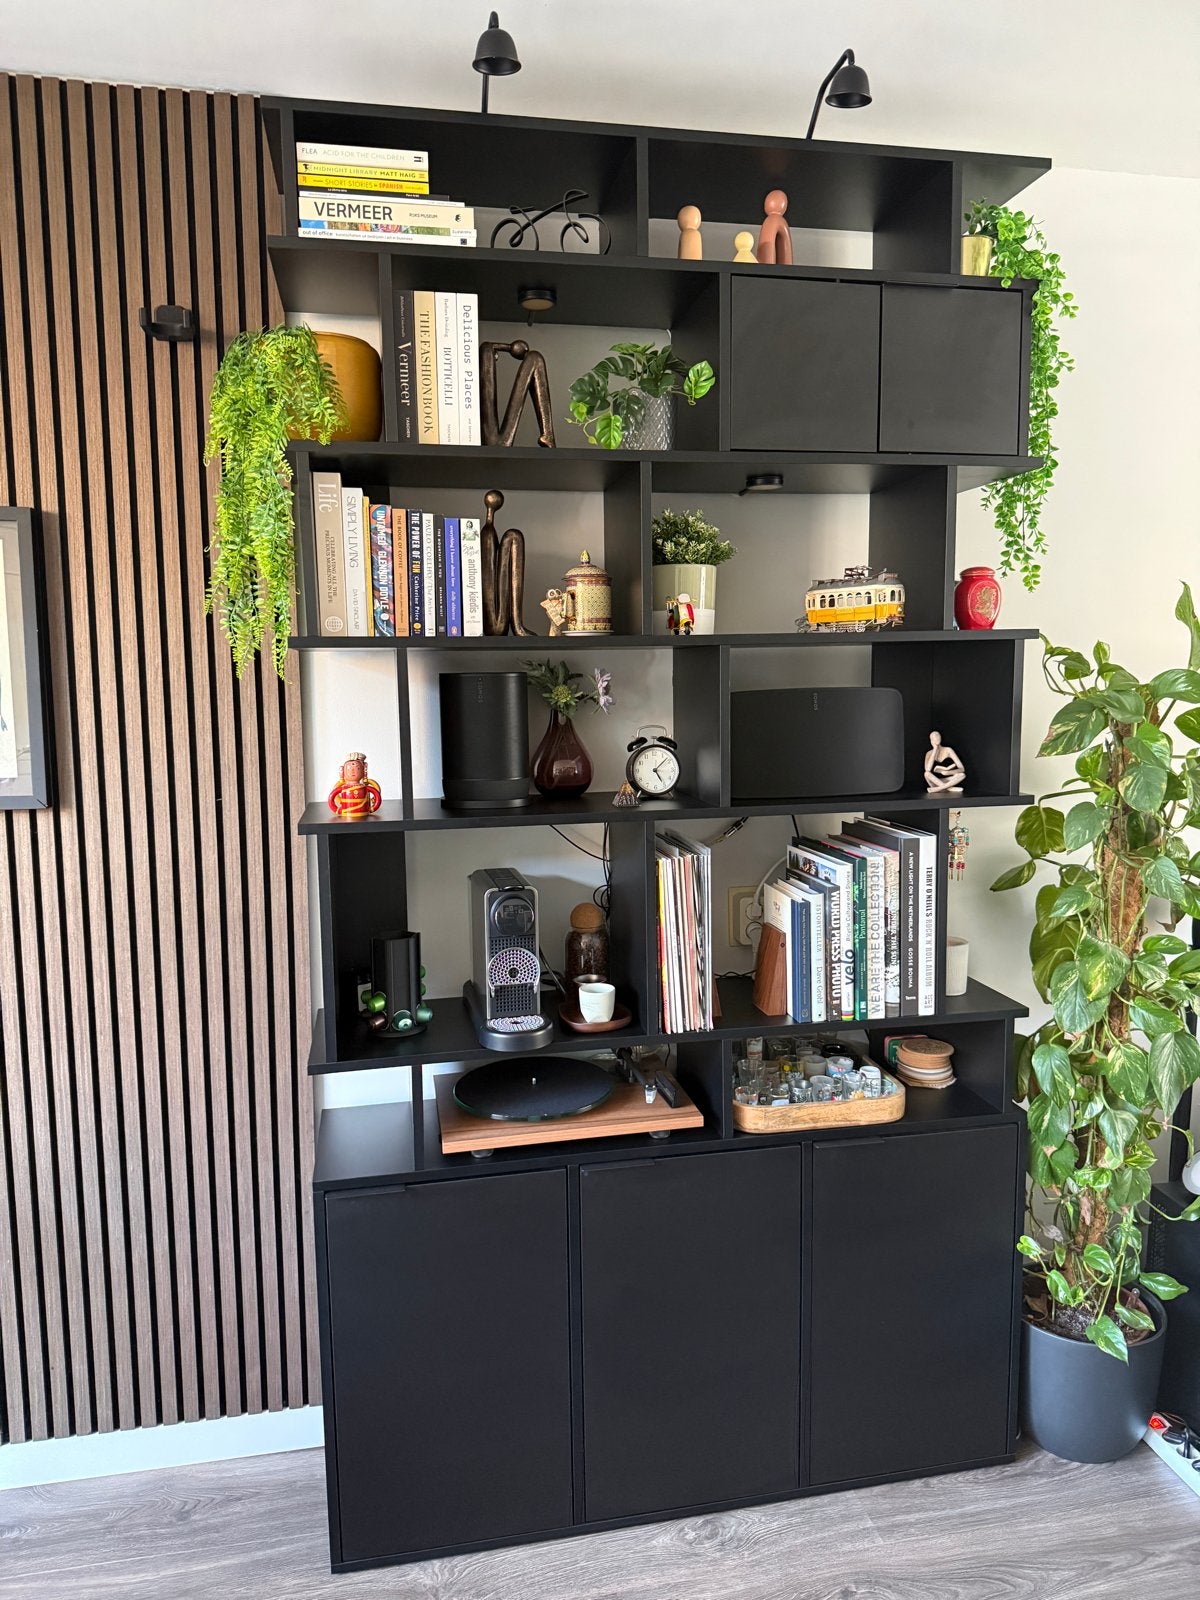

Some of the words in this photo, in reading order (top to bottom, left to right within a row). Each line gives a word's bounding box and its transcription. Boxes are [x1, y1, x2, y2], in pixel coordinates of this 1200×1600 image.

[314, 202, 393, 221] VERMEER
[420, 311, 430, 338] THE
[463, 305, 472, 364] Delicious
[398, 341, 412, 406] Vermeer
[421, 340, 432, 395] FASHION
[443, 347, 453, 406] BOTTICELLI
[465, 371, 473, 409] Places
[422, 398, 433, 434] BOOK
[318, 483, 338, 512] Life
[346, 496, 357, 536] SIMPLY
[376, 511, 388, 546] UNTAMED
[411, 513, 420, 524] THE
[348, 537, 358, 568] LIVING
[412, 526, 420, 549] POWER
[378, 551, 388, 584] GLENNON
[412, 550, 420, 559] OF
[412, 561, 420, 573] FUN
[466, 559, 478, 590] anthony
[380, 587, 389, 609] DOYLE
[469, 591, 479, 613] kiedis
[870, 862, 880, 940] COLLECTION!
[908, 886, 913, 894] ON
[831, 890, 840, 928] WORLD
[831, 929, 841, 961] PRESS
[870, 941, 880, 966] THE
[832, 964, 841, 997] PHOTO
[841, 949, 854, 985] velo
[871, 968, 880, 992] ARE
[871, 994, 880, 1014] WE
